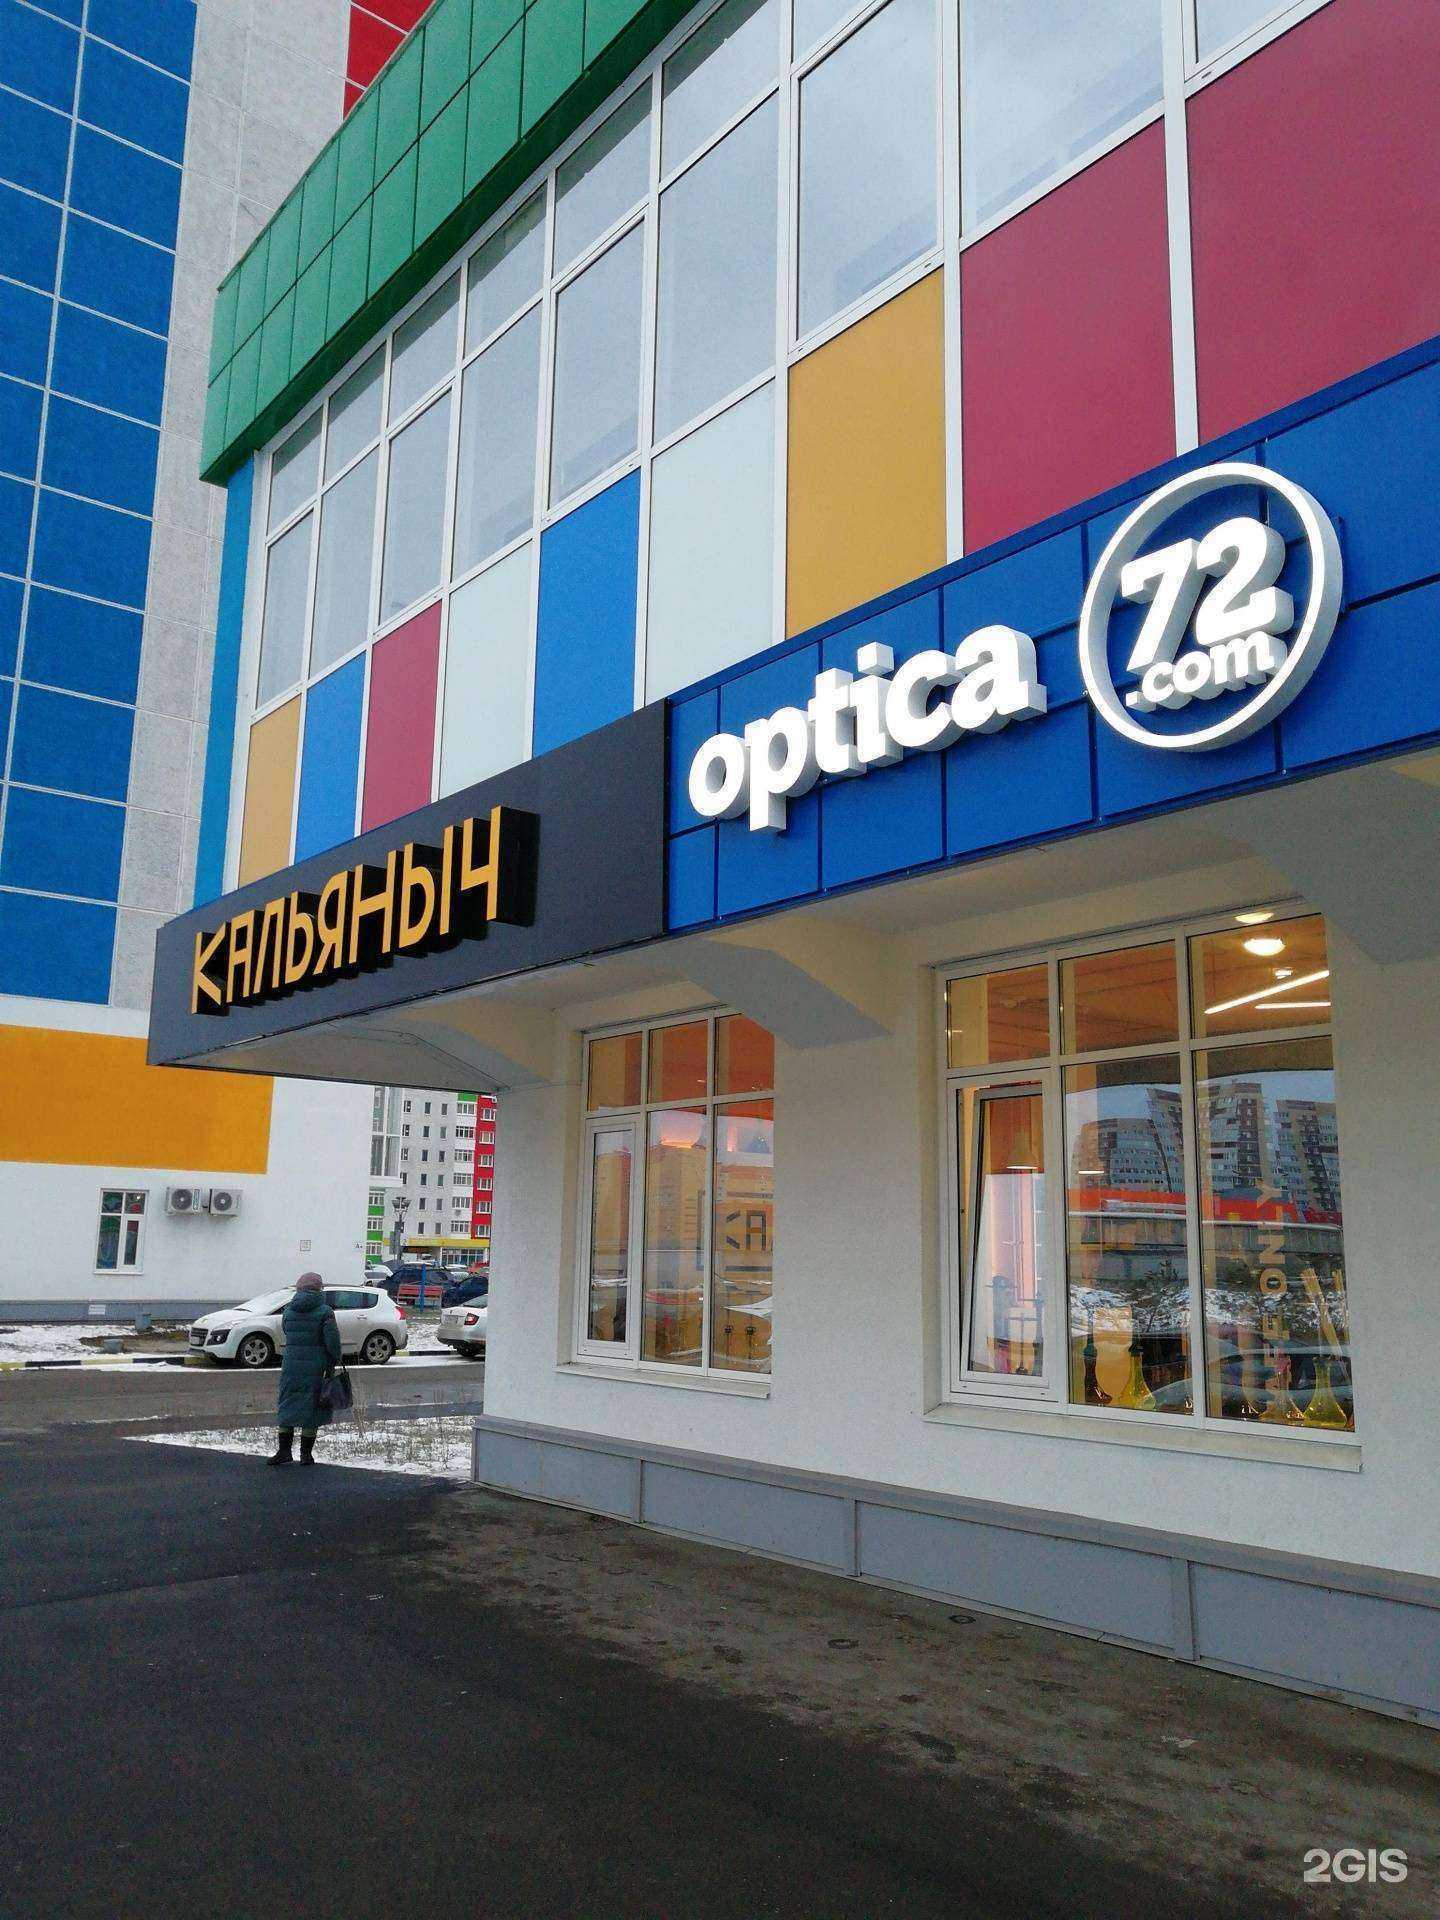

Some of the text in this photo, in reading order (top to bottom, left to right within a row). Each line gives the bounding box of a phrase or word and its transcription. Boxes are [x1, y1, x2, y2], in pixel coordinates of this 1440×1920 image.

[689, 517, 1294, 831] optica 72
[1126, 631, 1287, 713] .com
[190, 805, 512, 1015] КАЛЬЯНЫЧ
[1254, 1178, 1288, 1294] ONLY
